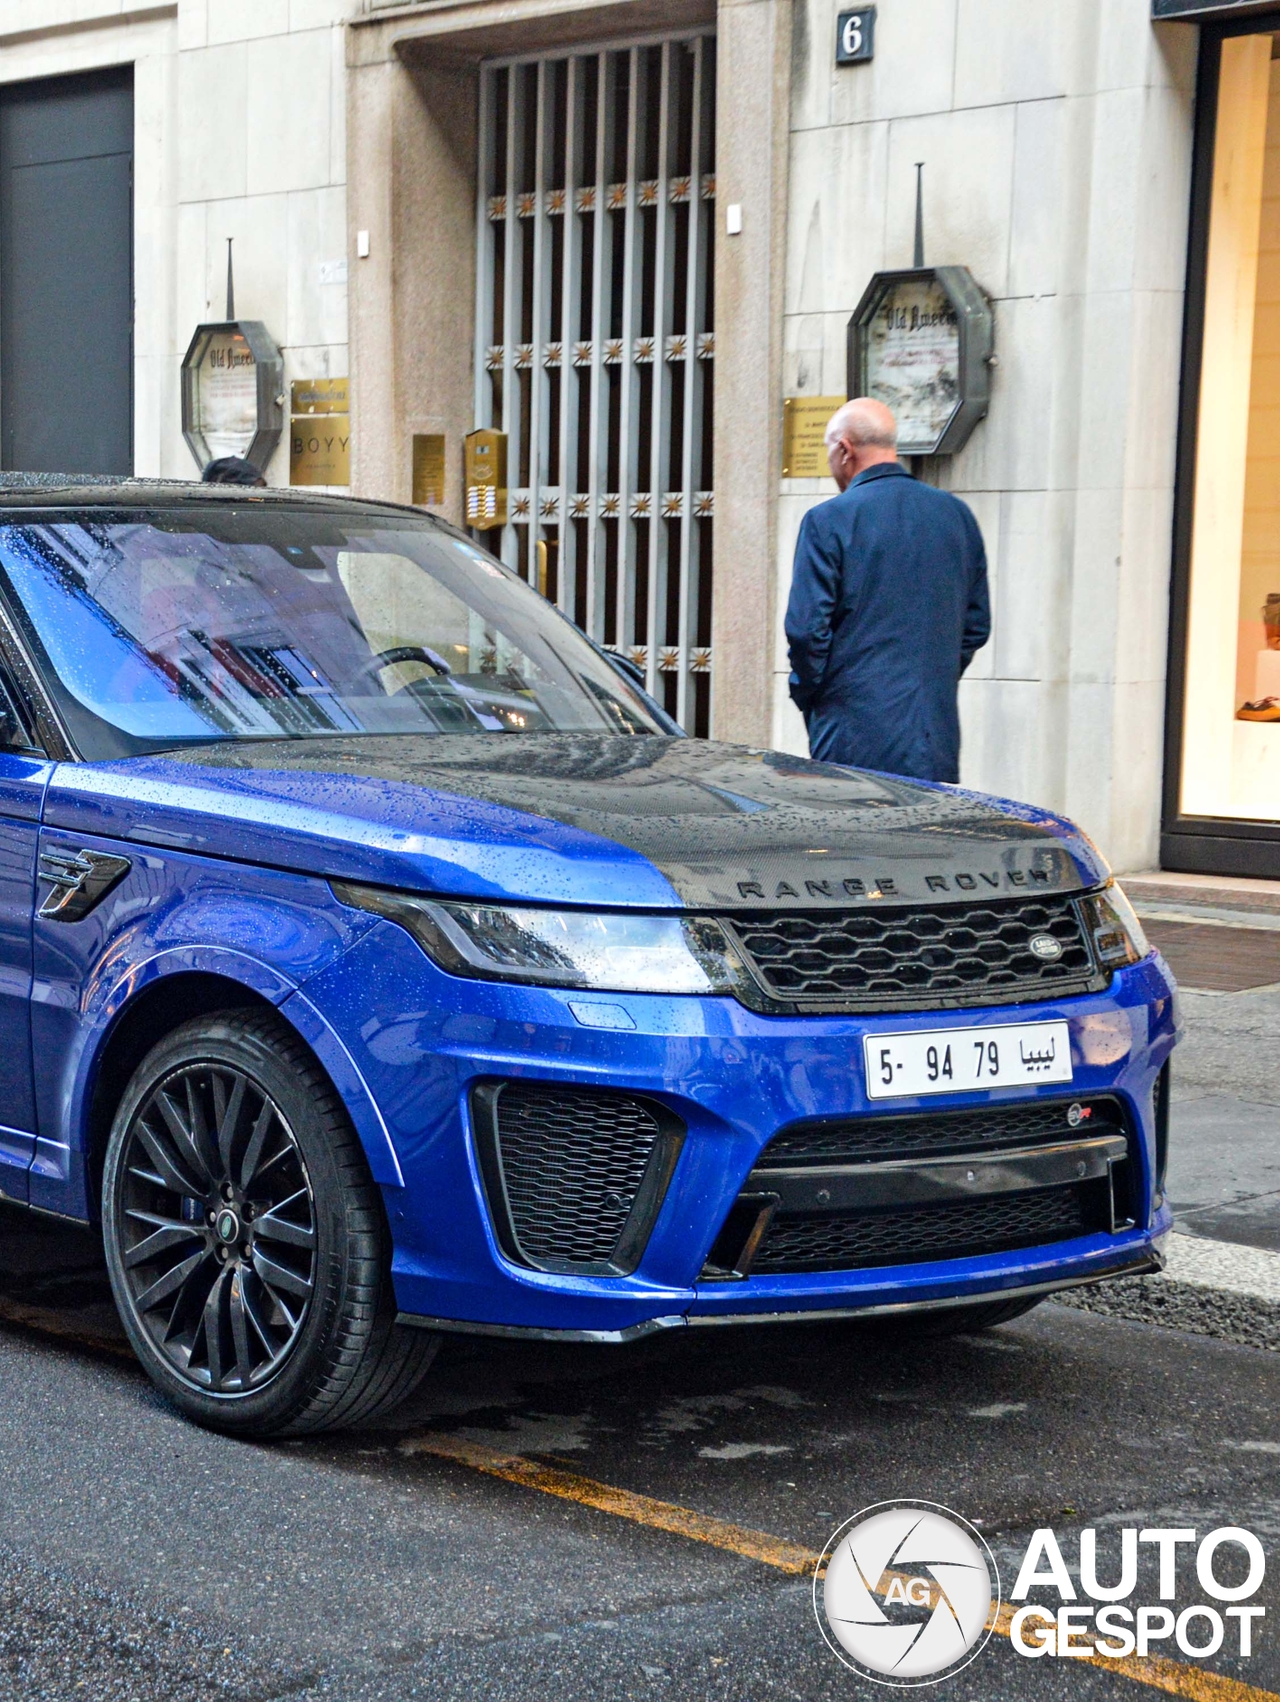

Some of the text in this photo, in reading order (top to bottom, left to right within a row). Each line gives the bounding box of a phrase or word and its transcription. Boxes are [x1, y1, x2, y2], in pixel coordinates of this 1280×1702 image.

[842, 15, 862, 54] 6
[210, 349, 225, 368] Old
[294, 437, 349, 454] BOYY
[737, 868, 1049, 899] RANGE ROVER
[927, 1044, 953, 1081] 94
[974, 1041, 999, 1077] 79
[1019, 1035, 1055, 1072] ليبيا
